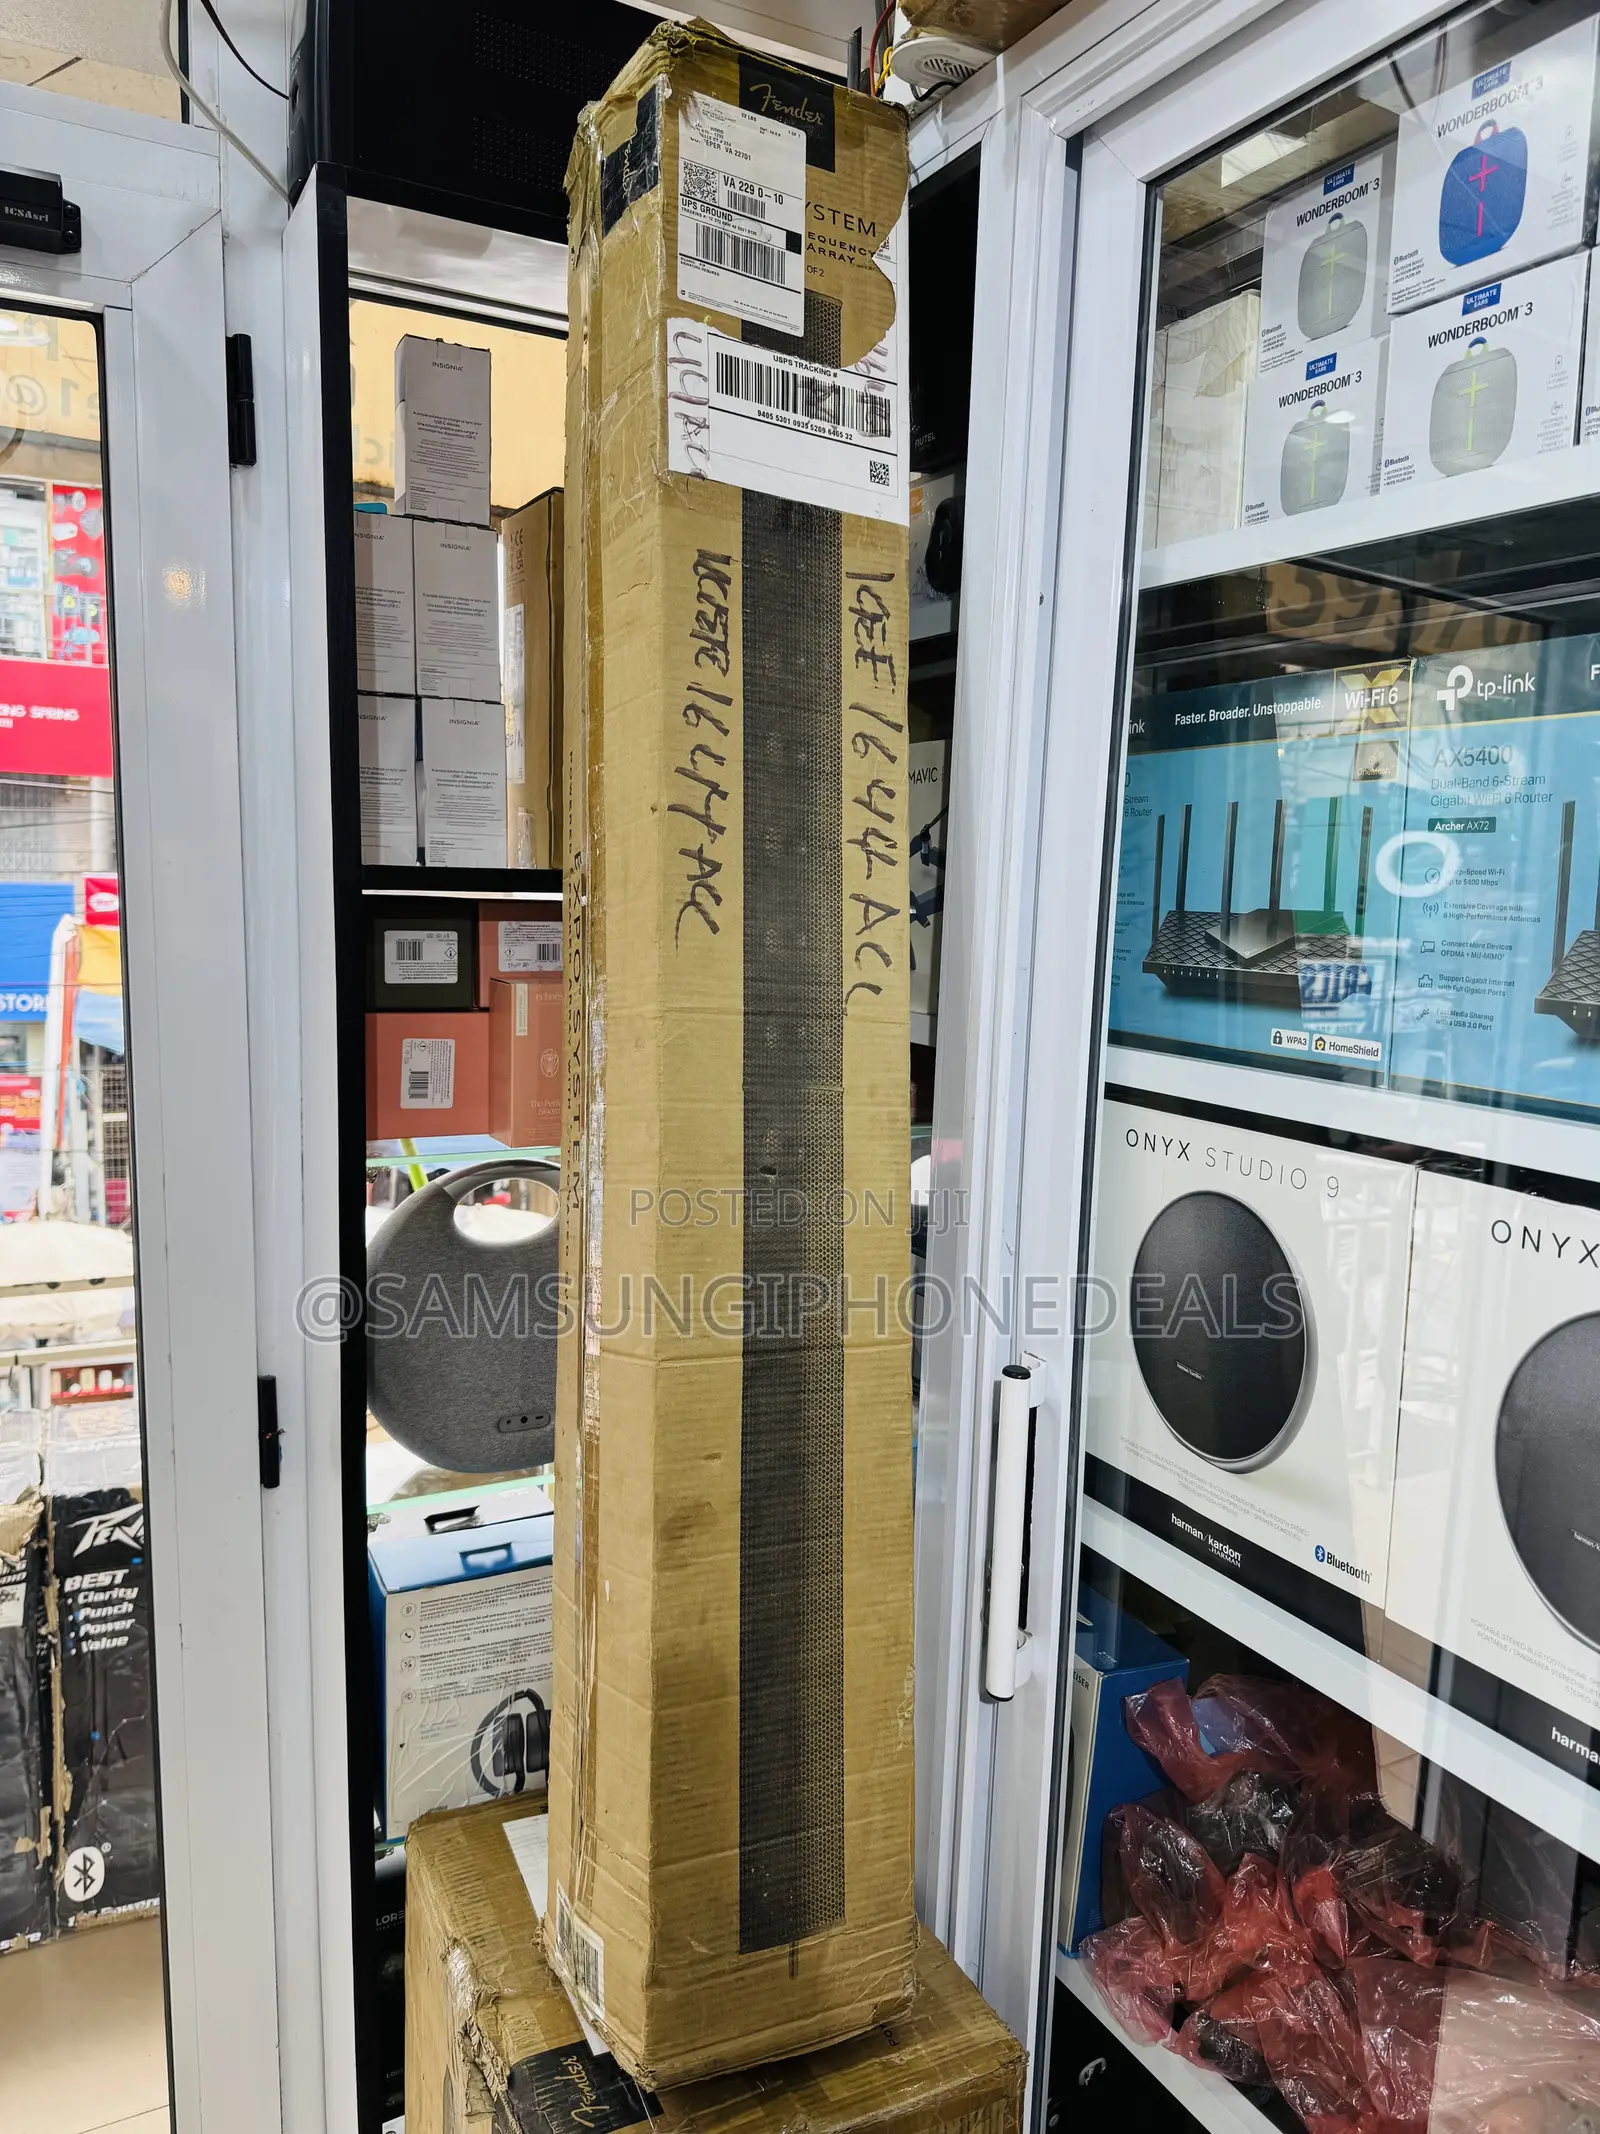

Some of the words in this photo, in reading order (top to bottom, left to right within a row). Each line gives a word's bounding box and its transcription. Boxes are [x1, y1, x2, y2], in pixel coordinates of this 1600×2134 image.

[749, 84, 823, 125] Fender
[1437, 82, 1529, 138] WONDERBOOM
[1535, 76, 1544, 91] 3
[723, 175, 736, 189] VA
[738, 180, 755, 195] 229
[1326, 169, 1351, 185] ULTIMATE
[681, 198, 698, 210] UPS
[700, 203, 733, 222] GROUND
[1296, 183, 1369, 227] WONDERBOOM
[1373, 178, 1380, 191] 3
[806, 243, 856, 264] ARRAY
[808, 231, 877, 258] EQUENCY
[1399, 249, 1418, 262] Bluetooth
[806, 265, 818, 275] OF
[1466, 288, 1498, 305] ULTIMATE
[1474, 298, 1489, 308] EARS
[1428, 306, 1519, 348] WONDERBOOM
[1524, 302, 1533, 316] 3
[432, 362, 463, 372] INSIGNIA
[773, 355, 793, 367] USPS
[794, 359, 832, 378] TRACKING
[1309, 357, 1334, 371] ULTIMATE
[1315, 366, 1327, 374] EARS
[1278, 375, 1351, 408] WONDERBOOM
[1355, 370, 1362, 383] 3
[757, 409, 774, 420] 9405
[775, 414, 791, 425] 5301
[440, 543, 472, 551] INSIGNIA
[1477, 672, 1536, 700] tp-link
[1344, 691, 1385, 710] Wi-Fi
[1388, 686, 1399, 705] 6
[1175, 713, 1207, 726] Faster.
[1209, 708, 1251, 722] Broader.
[1253, 698, 1324, 717] Unstoppable.
[449, 718, 480, 726] INSIGNIA
[1433, 745, 1513, 767] AX5400
[908, 766, 938, 784] MAVIC
[1431, 776, 1489, 790] Dual-Band
[1492, 775, 1546, 787] 6-Stream
[1430, 795, 1470, 808] Gigabit
[1473, 793, 1502, 805] Wi-Fi
[1504, 792, 1512, 804] 6
[1514, 791, 1553, 804] Router
[1130, 807, 1152, 818] Router
[1434, 821, 1465, 831] Archer
[1466, 821, 1490, 830] AX72
[1488, 868, 1505, 876] Wi-Fi
[1440, 950, 1465, 958] OFDMA
[1441, 940, 1468, 948] Connect
[1486, 943, 1513, 951] Devices
[1438, 974, 1465, 983] Support
[1465, 976, 1487, 985] Gigabit
[1488, 978, 1515, 987] Internet
[1464, 986, 1486, 995] Gigabit
[1487, 989, 1506, 997] Ports
[1451, 1010, 1468, 1018] Media
[1469, 1012, 1494, 1021] Sharing
[1453, 1020, 1467, 1028] USB
[1478, 1023, 1492, 1031] Port
[1286, 1035, 1307, 1046] WPA3
[1329, 1041, 1379, 1057] HomeShield
[1126, 1129, 1191, 1161] ONYX
[1205, 1147, 1307, 1190] STUDIO
[1326, 1176, 1339, 1198] 9
[1491, 1219, 1600, 1268] ONYX
[1211, 1548, 1241, 1569] HARMAN
[1326, 1552, 1371, 1584] Bluetooth
[64, 1569, 130, 1593] BEST
[77, 1587, 139, 1606] Clarity
[79, 1602, 135, 1621] Punch
[79, 1618, 136, 1638] Power
[81, 1635, 129, 1653] Value
[561, 2055, 610, 2128] Fender
